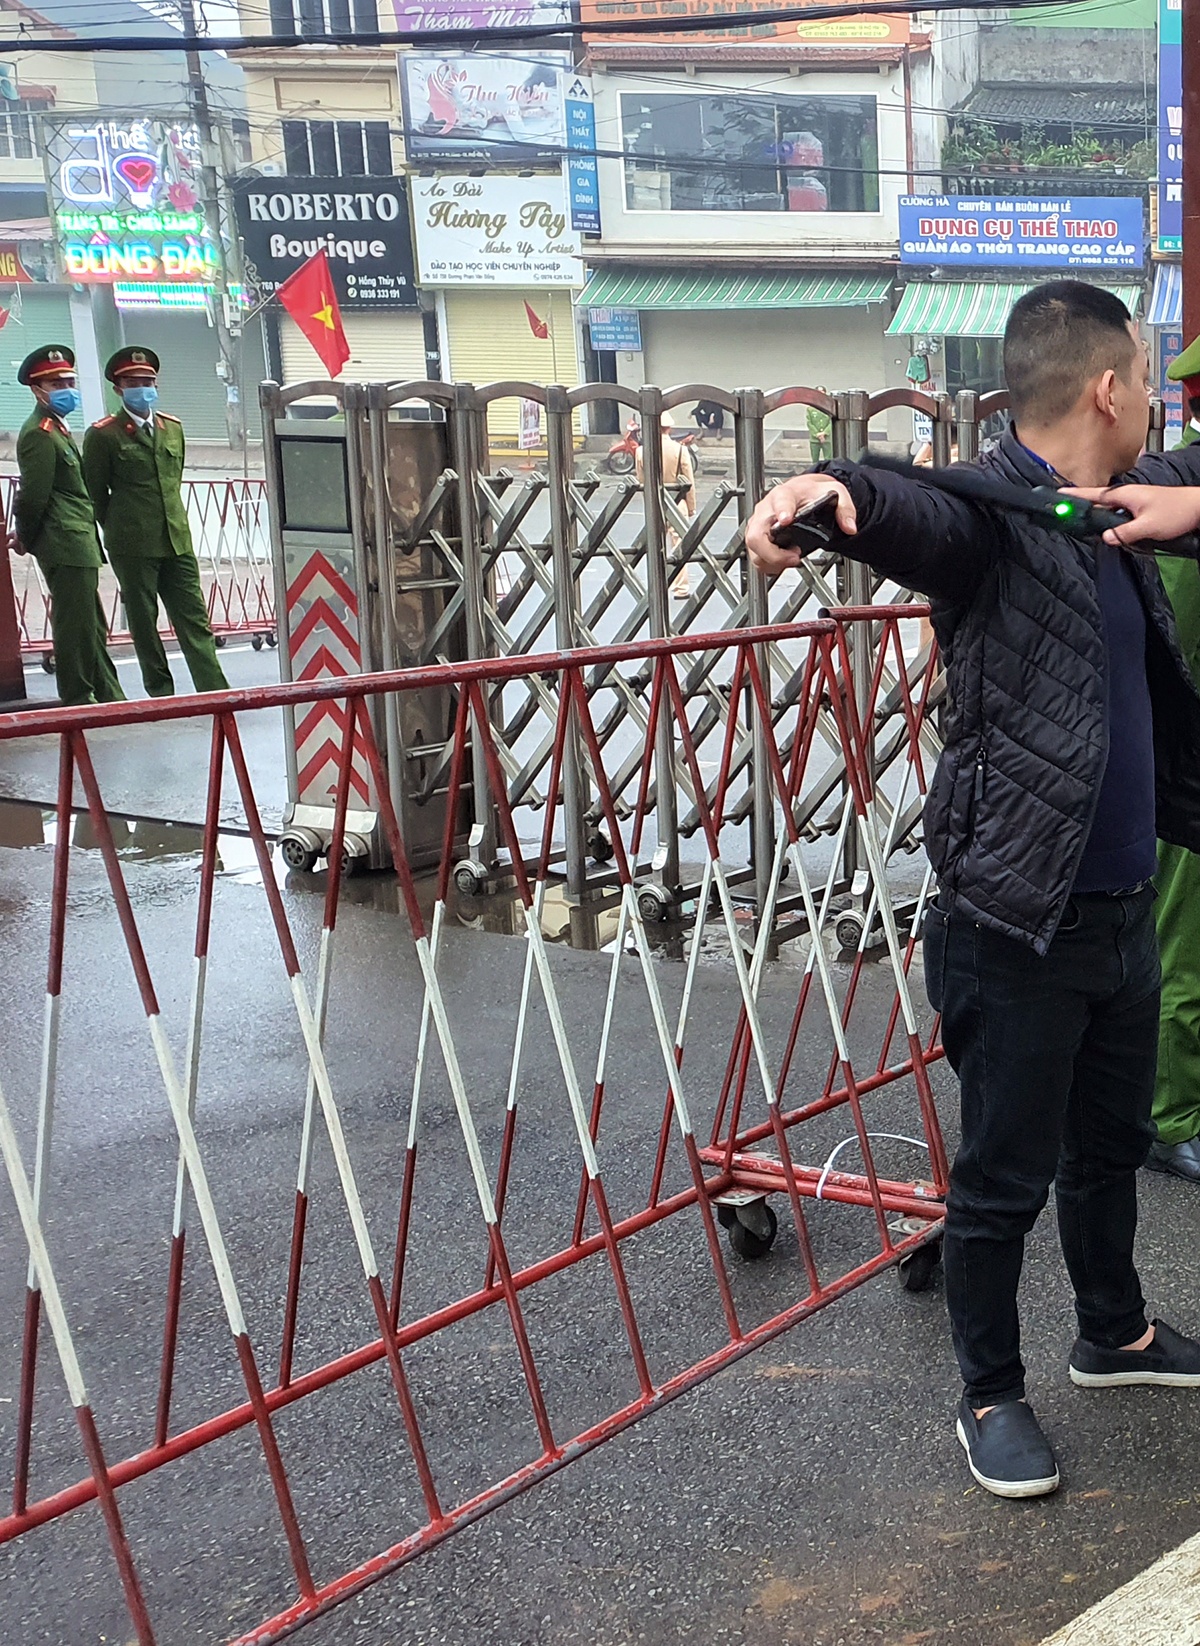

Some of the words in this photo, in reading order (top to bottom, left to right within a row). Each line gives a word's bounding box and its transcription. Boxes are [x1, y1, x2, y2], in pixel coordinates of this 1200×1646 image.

[577, 177, 591, 188] GIA
[248, 193, 399, 222] ROBERTO
[957, 201, 992, 212] CHUYÊN
[995, 200, 1014, 213] BÁN
[1040, 200, 1059, 213] BÁN
[426, 201, 507, 239] Hương
[519, 201, 566, 239] Tây
[919, 218, 979, 240] DỤNG
[984, 218, 1012, 241] CỤ
[1018, 213, 1060, 238] THỂ
[1063, 219, 1118, 239] THAO
[270, 232, 387, 264] Boutique
[479, 241, 512, 254] Make
[517, 241, 535, 259] Up
[538, 242, 575, 255] Artist
[976, 239, 1013, 255] THỜI
[1017, 243, 1071, 255] TRANG
[1071, 243, 1102, 256] CAO
[1105, 240, 1136, 256] CẤP
